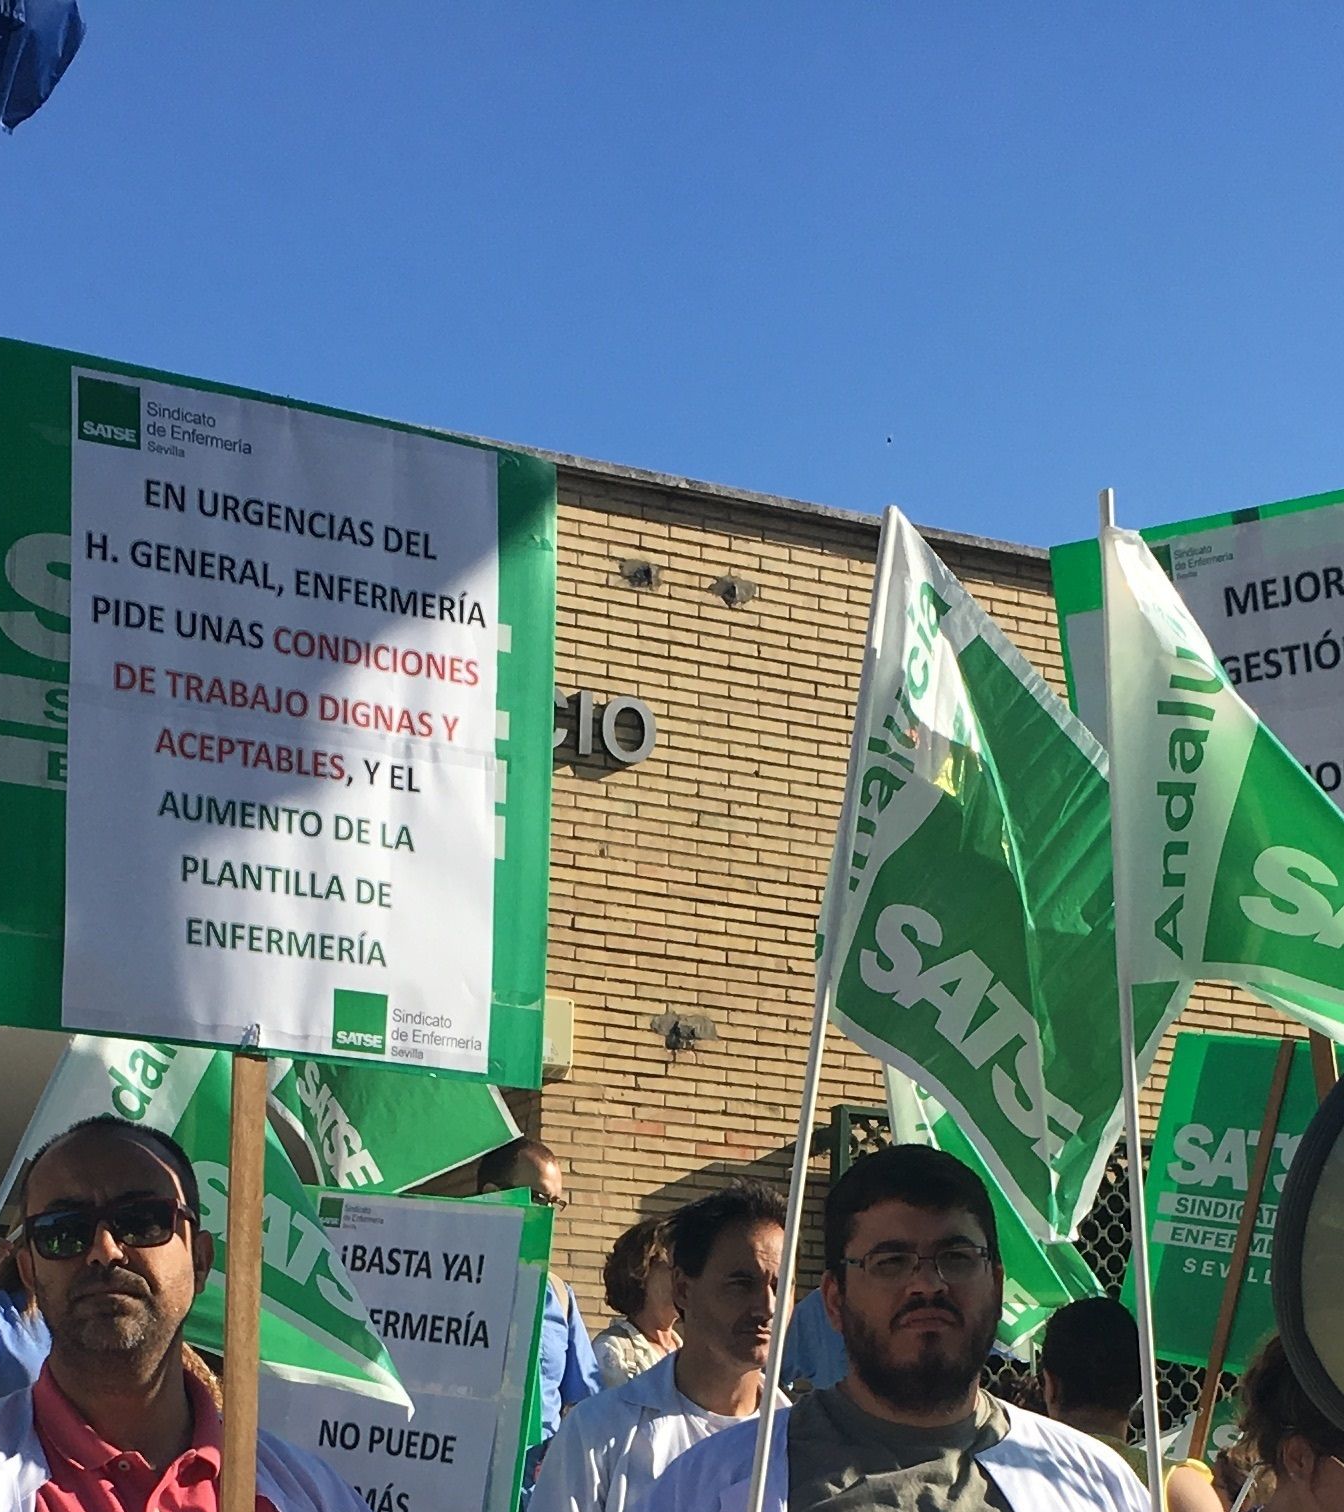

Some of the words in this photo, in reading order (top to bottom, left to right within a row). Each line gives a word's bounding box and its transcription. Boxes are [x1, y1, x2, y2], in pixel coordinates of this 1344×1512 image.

[83, 421, 136, 443] SATSE
[146, 401, 216, 428] Sindicato
[146, 421, 167, 437] de
[171, 425, 252, 455] Enfermería
[147, 441, 185, 458] Sevilla
[145, 479, 187, 513] EN
[197, 487, 375, 549] URGENCIAS
[383, 525, 437, 561] DEL
[86, 531, 118, 565] H.
[131, 538, 285, 598] GENERAL,
[294, 569, 487, 629] ENFERMERÍA
[92, 594, 165, 634] PIDE
[175, 610, 264, 651] UNAS
[273, 625, 479, 688] CONDICIONES
[114, 662, 157, 695] DE
[165, 671, 309, 720] TRABAJO
[318, 697, 432, 740] DIGNAS
[442, 713, 460, 742] Y
[156, 728, 353, 787] ACEPTABLES,
[363, 759, 381, 785] Y
[389, 764, 421, 794] EL
[159, 790, 324, 837] AUMENTO
[333, 815, 371, 846] DE
[379, 823, 416, 853] LA
[181, 855, 346, 902] PLANTILLA
[355, 878, 393, 909] DE
[185, 918, 387, 968] ENFERMERÍA
[391, 1028, 408, 1042] de
[412, 1029, 482, 1051] Enfermería
[392, 1008, 452, 1029] Sindicato
[336, 1031, 383, 1049] SATSE
[390, 1046, 424, 1060] Sevilla
[341, 1244, 432, 1279] ¡BASTA
[442, 1253, 485, 1284] YA!
[319, 1419, 361, 1451] NO
[369, 1426, 457, 1464] PUEDE
